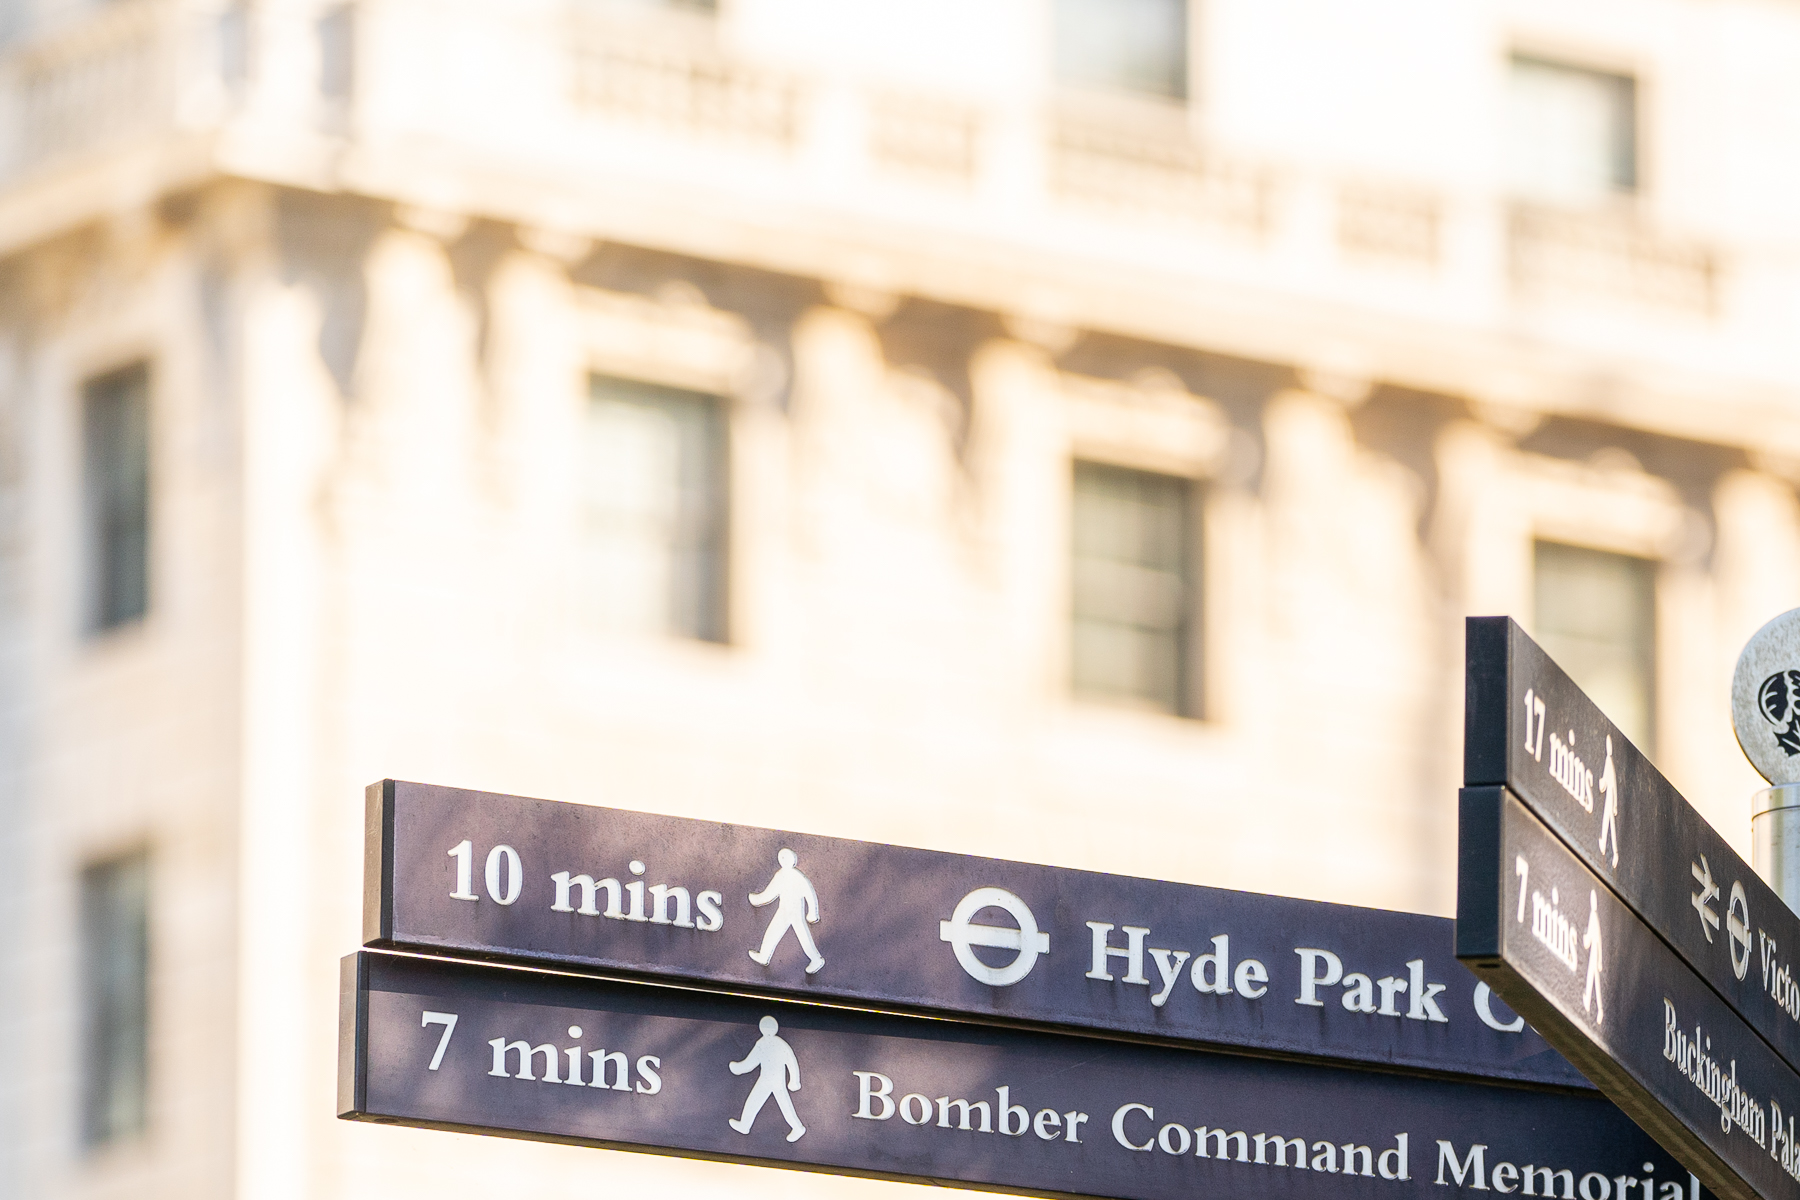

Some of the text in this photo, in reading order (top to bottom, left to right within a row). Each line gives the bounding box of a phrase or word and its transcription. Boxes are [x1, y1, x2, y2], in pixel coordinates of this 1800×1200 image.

[1523, 687, 1546, 763] 17
[1548, 728, 1595, 815] mins
[446, 838, 523, 906] 10
[551, 860, 724, 932] mins
[1085, 921, 1269, 1008] Hyde
[1294, 948, 1449, 1023] Park
[1515, 855, 1529, 924] 7
[1531, 886, 1579, 973] mins
[1662, 996, 1767, 1151] Buckingham
[421, 1010, 459, 1071] 7
[487, 1025, 662, 1096] mins
[851, 1070, 1089, 1144] Bomber
[1111, 1103, 1412, 1182] Command
